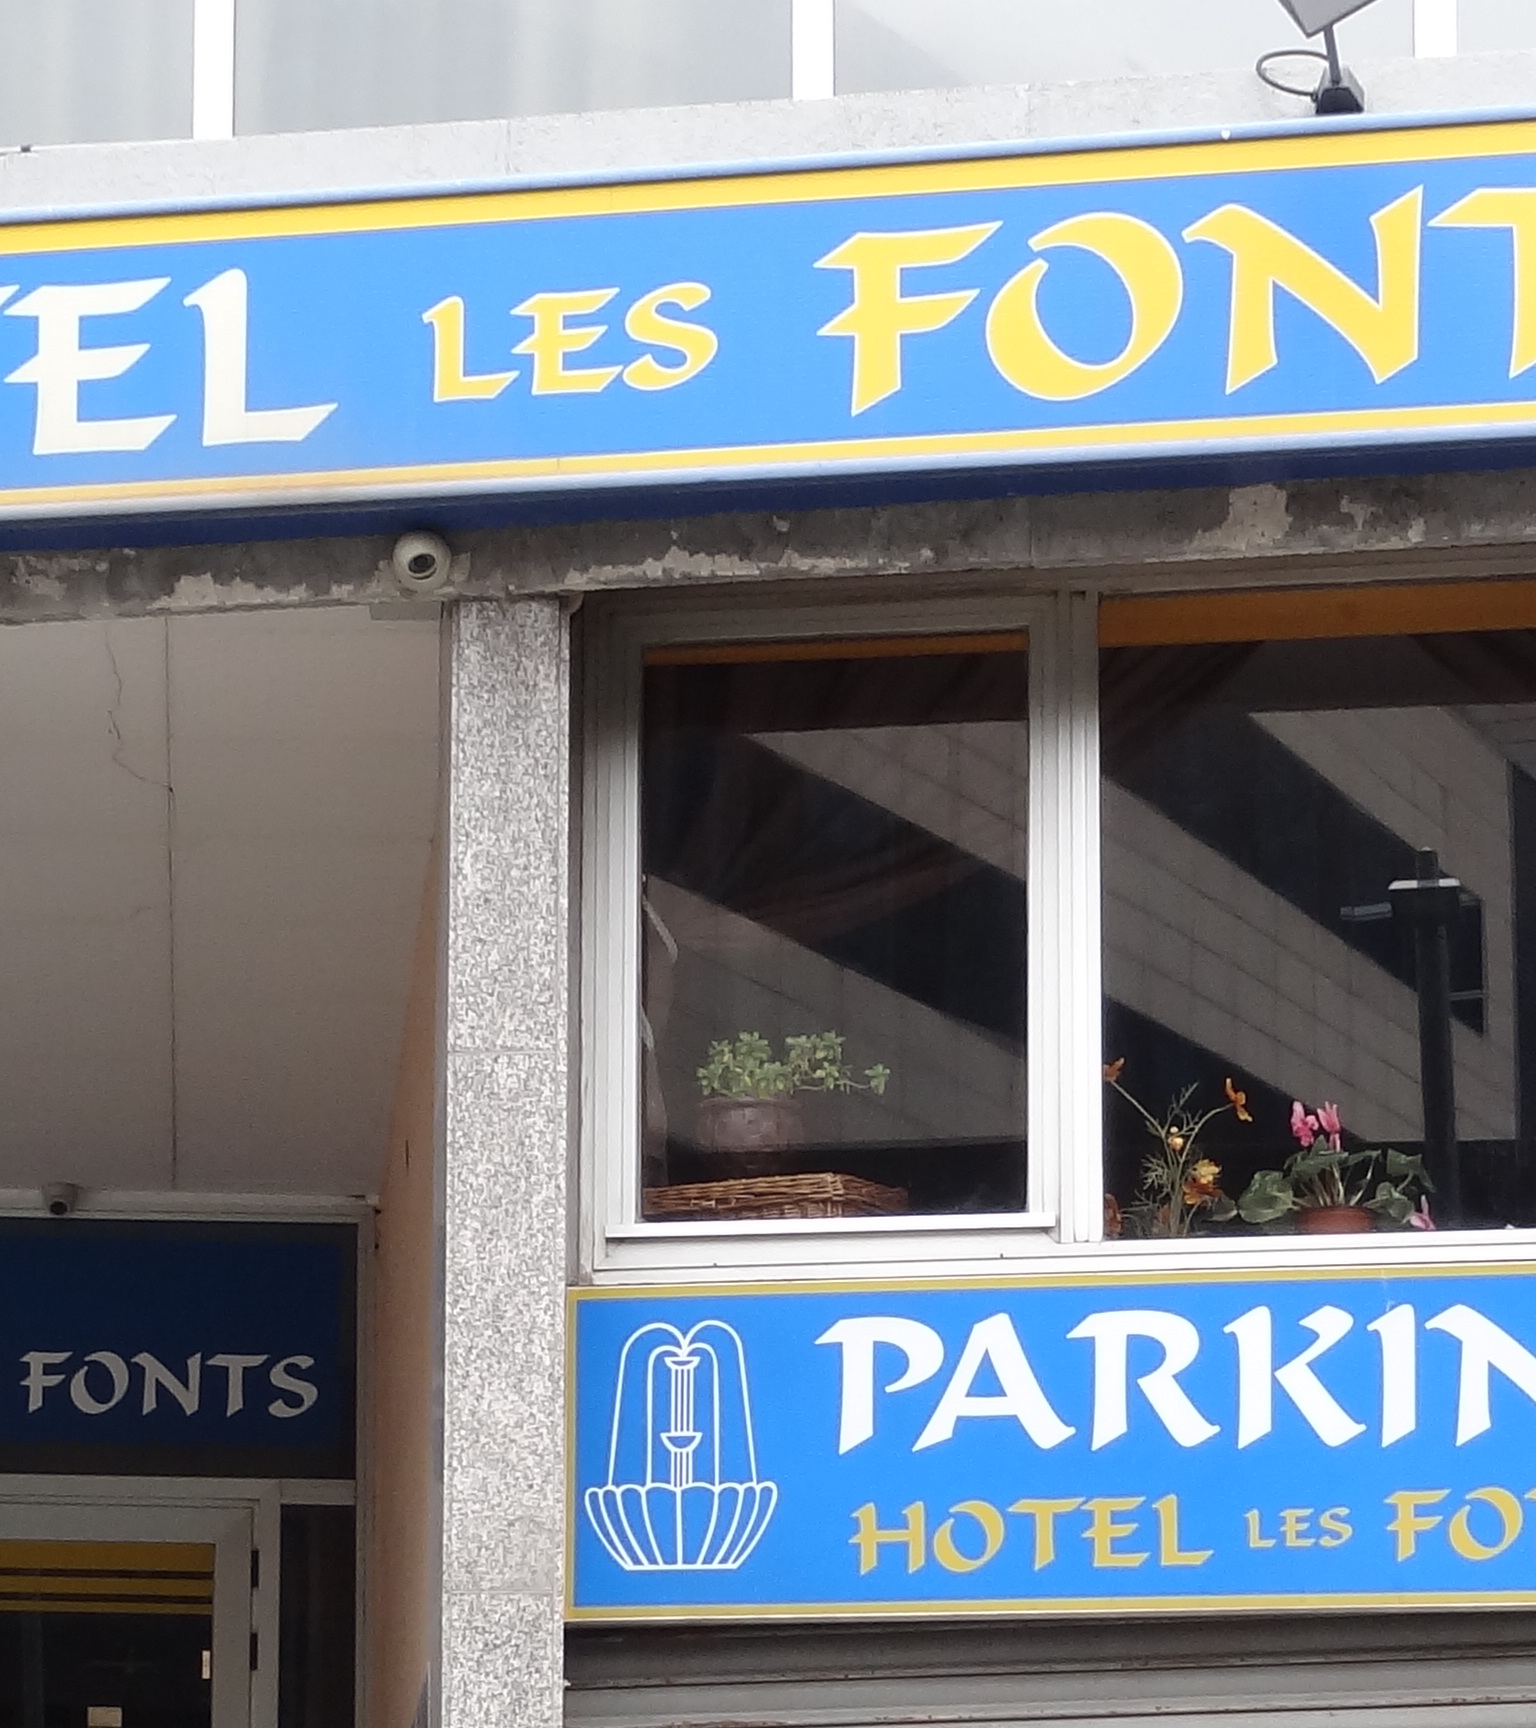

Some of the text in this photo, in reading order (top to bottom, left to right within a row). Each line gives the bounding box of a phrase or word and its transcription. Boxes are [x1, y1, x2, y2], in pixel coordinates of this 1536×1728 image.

[421, 280, 720, 404] LES
[18, 1350, 319, 1418] FONTS
[850, 1490, 1215, 1577] HOTEL
[1246, 1504, 1355, 1551] LES
